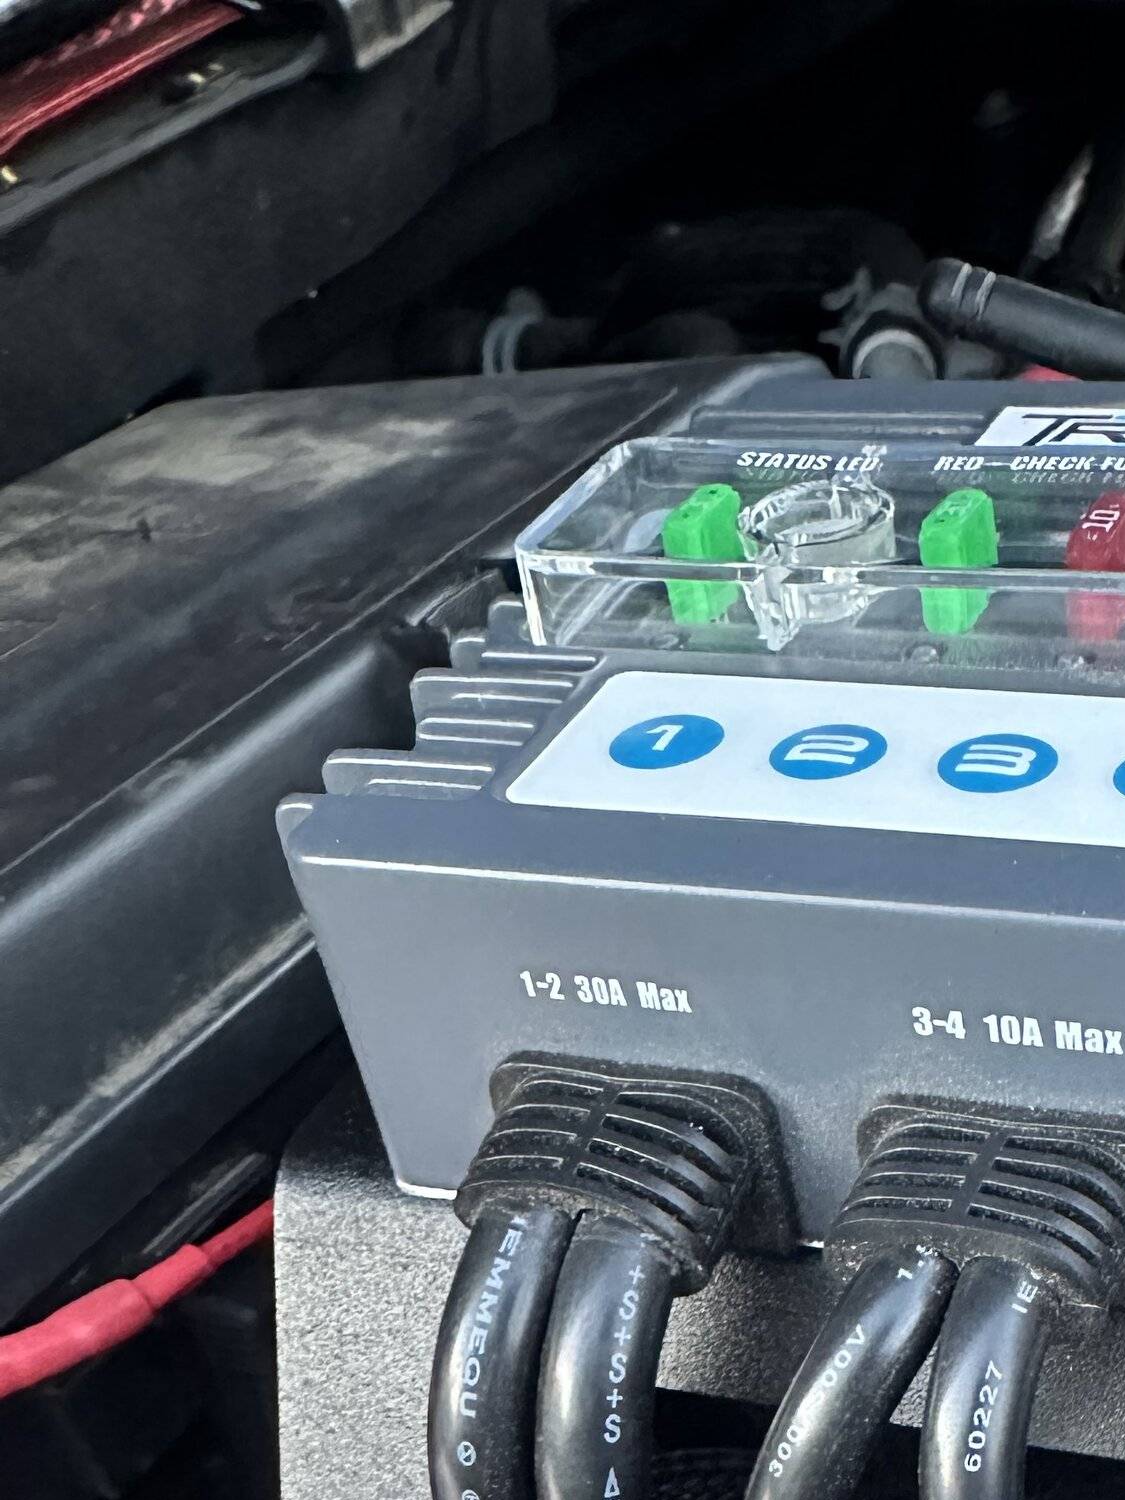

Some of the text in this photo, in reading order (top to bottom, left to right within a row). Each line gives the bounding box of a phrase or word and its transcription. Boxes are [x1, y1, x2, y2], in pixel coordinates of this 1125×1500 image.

[736, 451, 833, 471] STATUS
[1081, 509, 1121, 533] 10
[645, 724, 684, 751] 1
[783, 734, 869, 765] 2
[954, 744, 1037, 776] 3
[519, 970, 693, 1013] 1-2 30A Max
[911, 1006, 1124, 1055] 3-4 10A Max
[963, 1360, 1004, 1473] 60227
